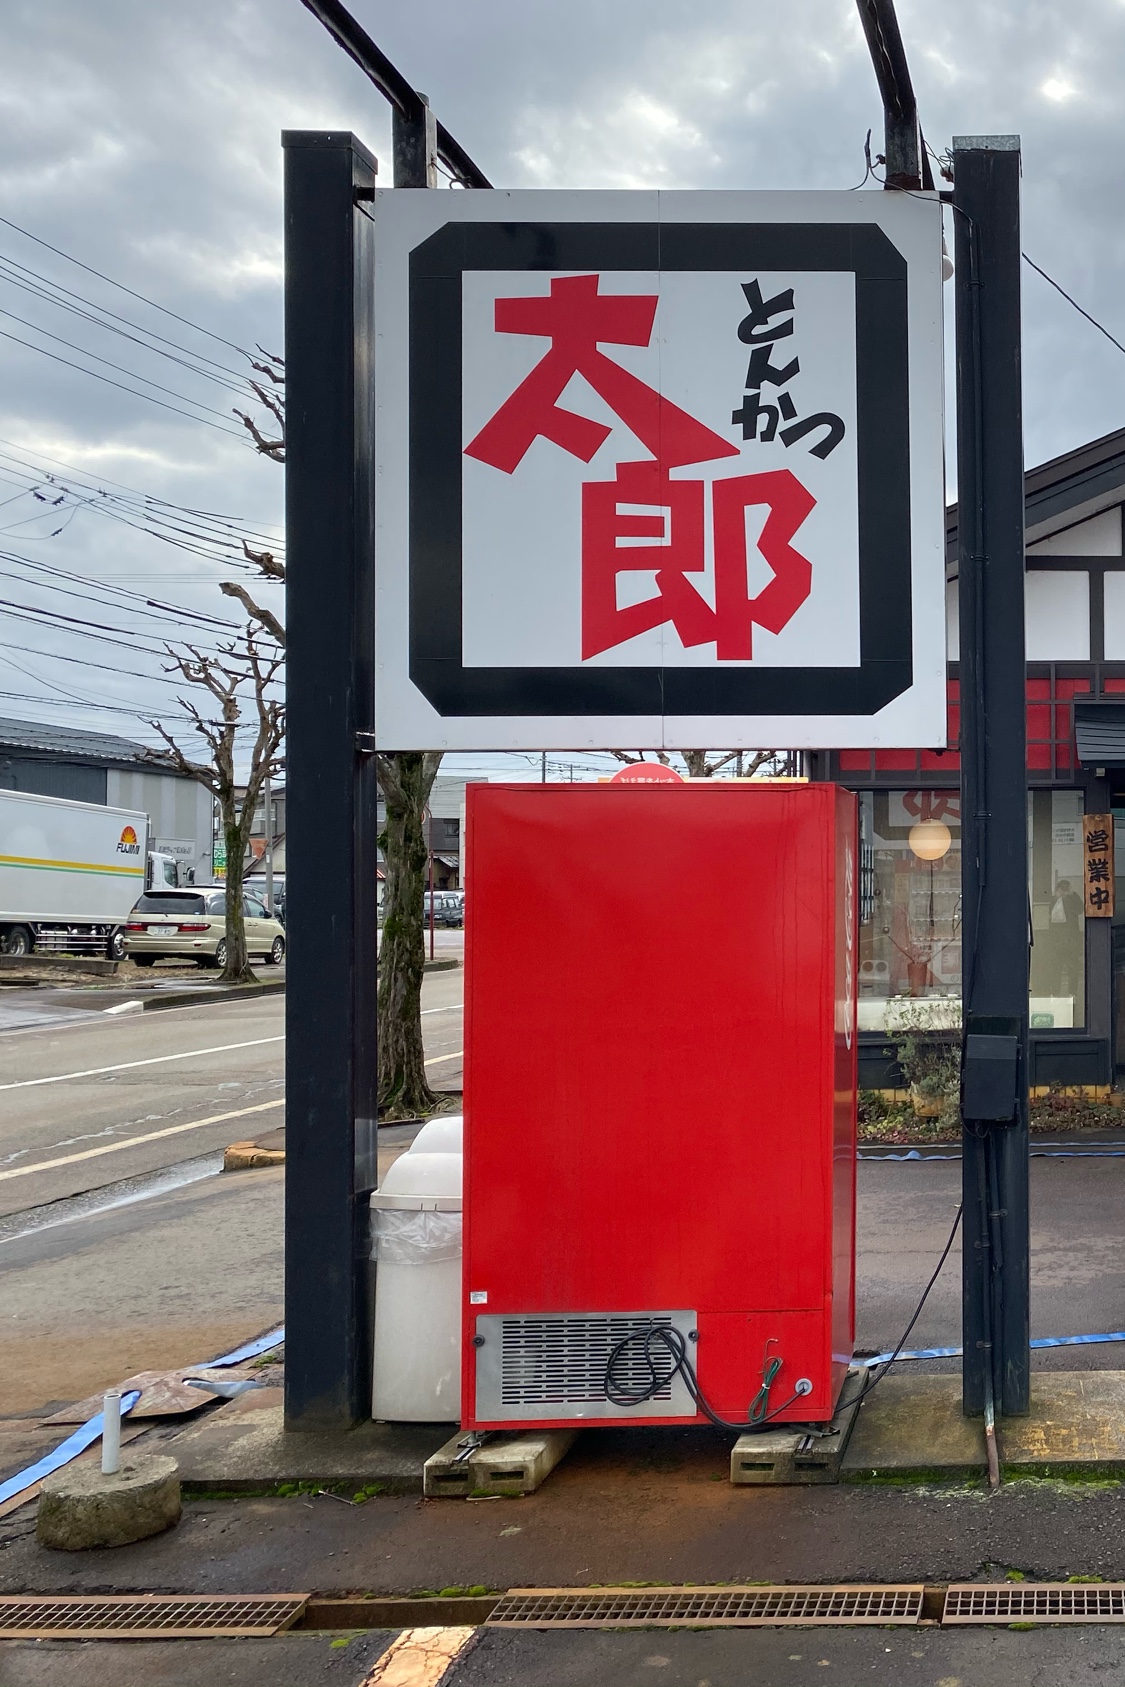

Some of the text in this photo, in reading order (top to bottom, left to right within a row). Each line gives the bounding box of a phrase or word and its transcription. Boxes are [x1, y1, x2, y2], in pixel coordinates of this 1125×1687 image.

[731, 278, 846, 460] とんかつ
[463, 274, 817, 661] 太郎
[1086, 829, 1110, 910] 営業中
